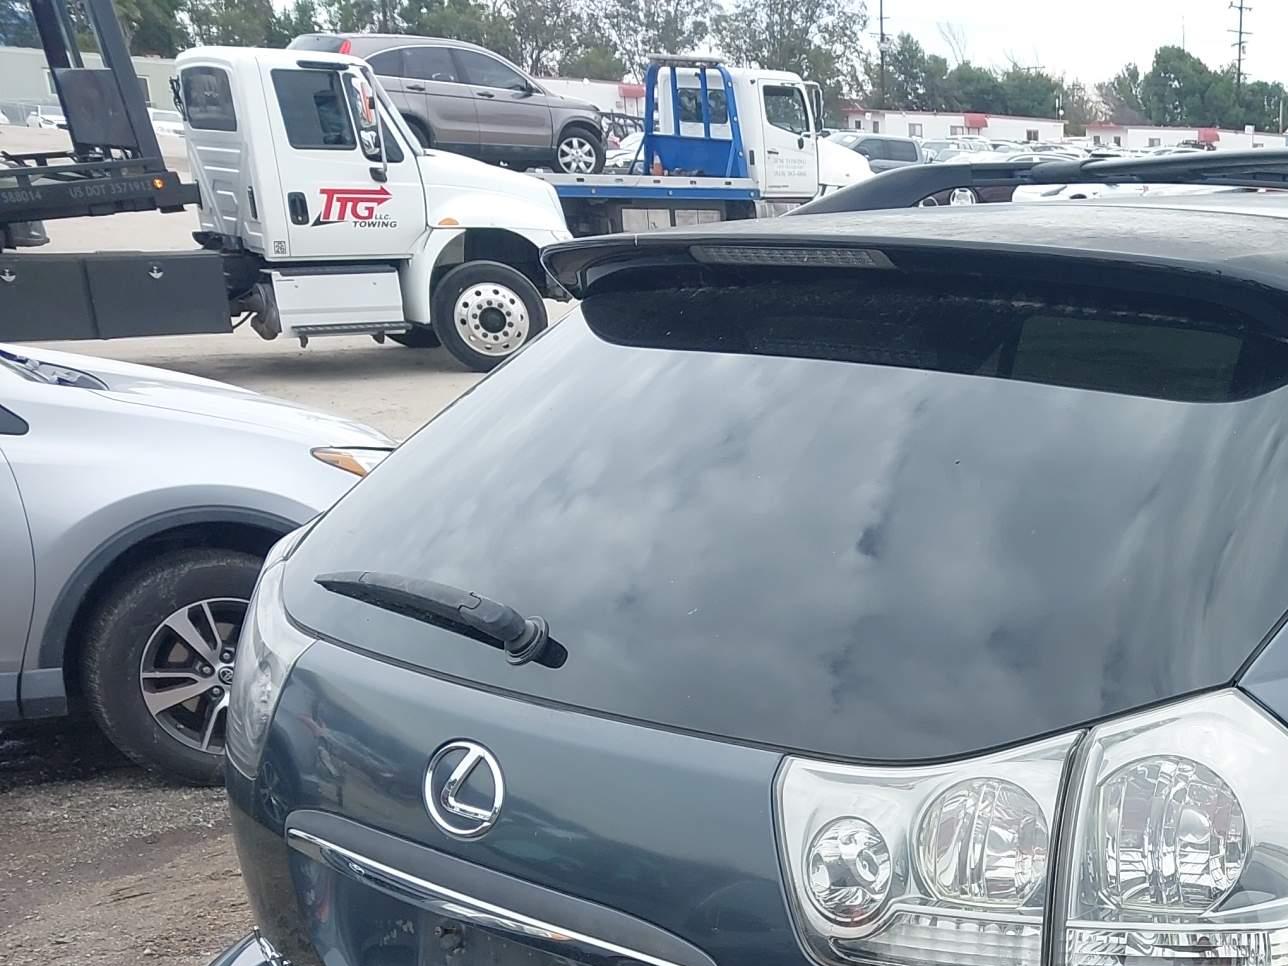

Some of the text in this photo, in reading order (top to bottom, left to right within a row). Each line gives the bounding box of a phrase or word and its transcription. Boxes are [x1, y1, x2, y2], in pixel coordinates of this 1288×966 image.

[68, 187, 84, 198] US
[85, 185, 106, 197] DOT
[319, 187, 386, 220] TTG
[352, 220, 397, 228] TOWING
